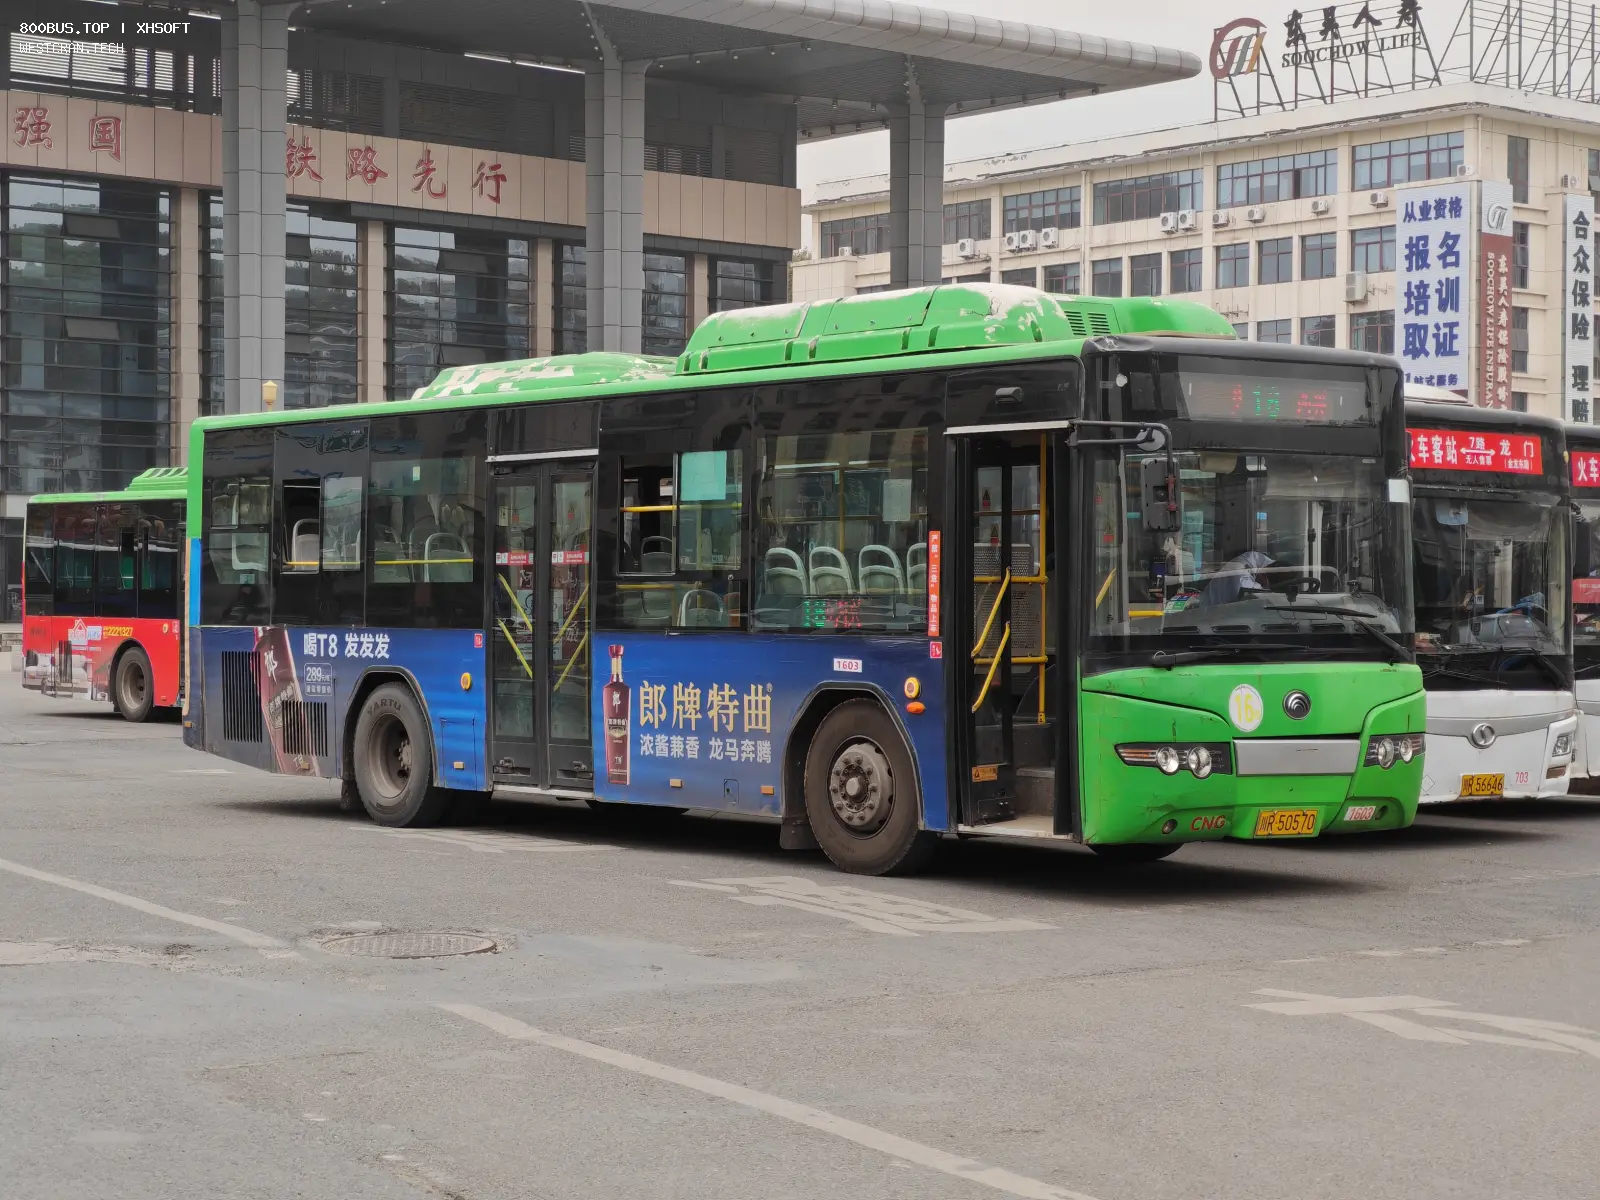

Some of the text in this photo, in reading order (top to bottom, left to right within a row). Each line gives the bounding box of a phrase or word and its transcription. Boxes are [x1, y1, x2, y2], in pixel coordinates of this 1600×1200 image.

[1284, 0, 1423, 47] 东吴人寿
[1281, 31, 1423, 68] SOOCHOW LIFE
[1402, 196, 1463, 223] 从业资格
[1404, 231, 1461, 272] 报名
[1404, 276, 1460, 316] 培训
[1486, 252, 1495, 317] SOOCHOW
[1571, 211, 1590, 424] 合众保险 理赔
[1403, 321, 1460, 360] 取证
[1410, 434, 1458, 465] 车客站
[303, 632, 390, 660] 喝T8 发发发
[836, 660, 860, 671] 1603
[640, 680, 772, 734] 郎牌特曲
[640, 733, 772, 764] 浓酱兼香 龙马奔腾
[1515, 771, 1528, 783] 703
[1190, 814, 1226, 832] CNG
[1348, 807, 1374, 820] 1603
